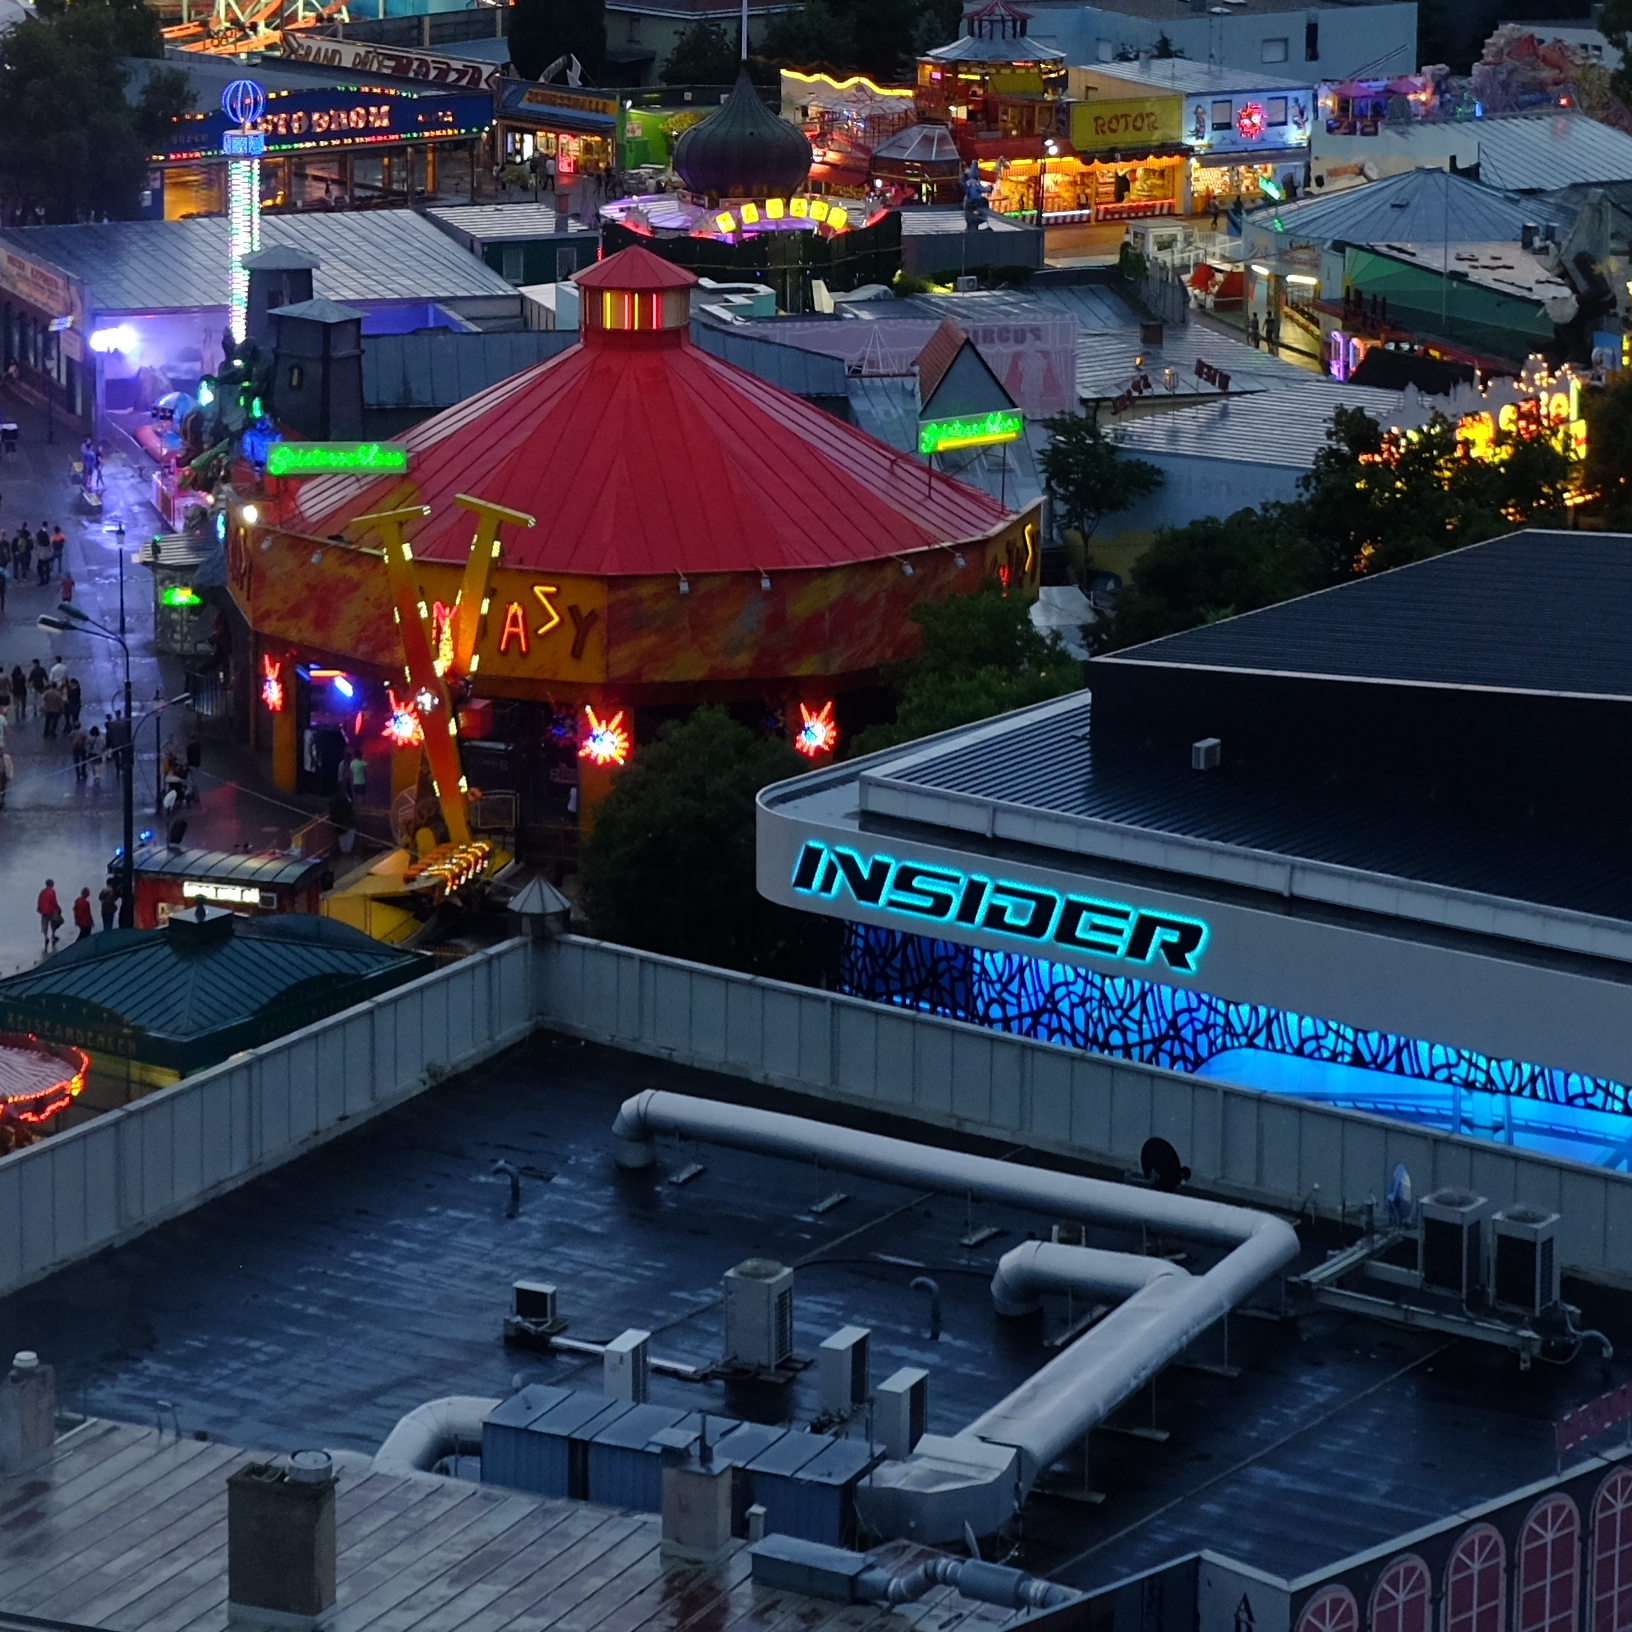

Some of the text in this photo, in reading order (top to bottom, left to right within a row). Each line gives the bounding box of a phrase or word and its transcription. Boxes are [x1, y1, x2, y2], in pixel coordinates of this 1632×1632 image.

[1092, 111, 1160, 136] ROTOR
[971, 325, 1045, 347] IRCUS
[792, 841, 1208, 974] INSIDER
